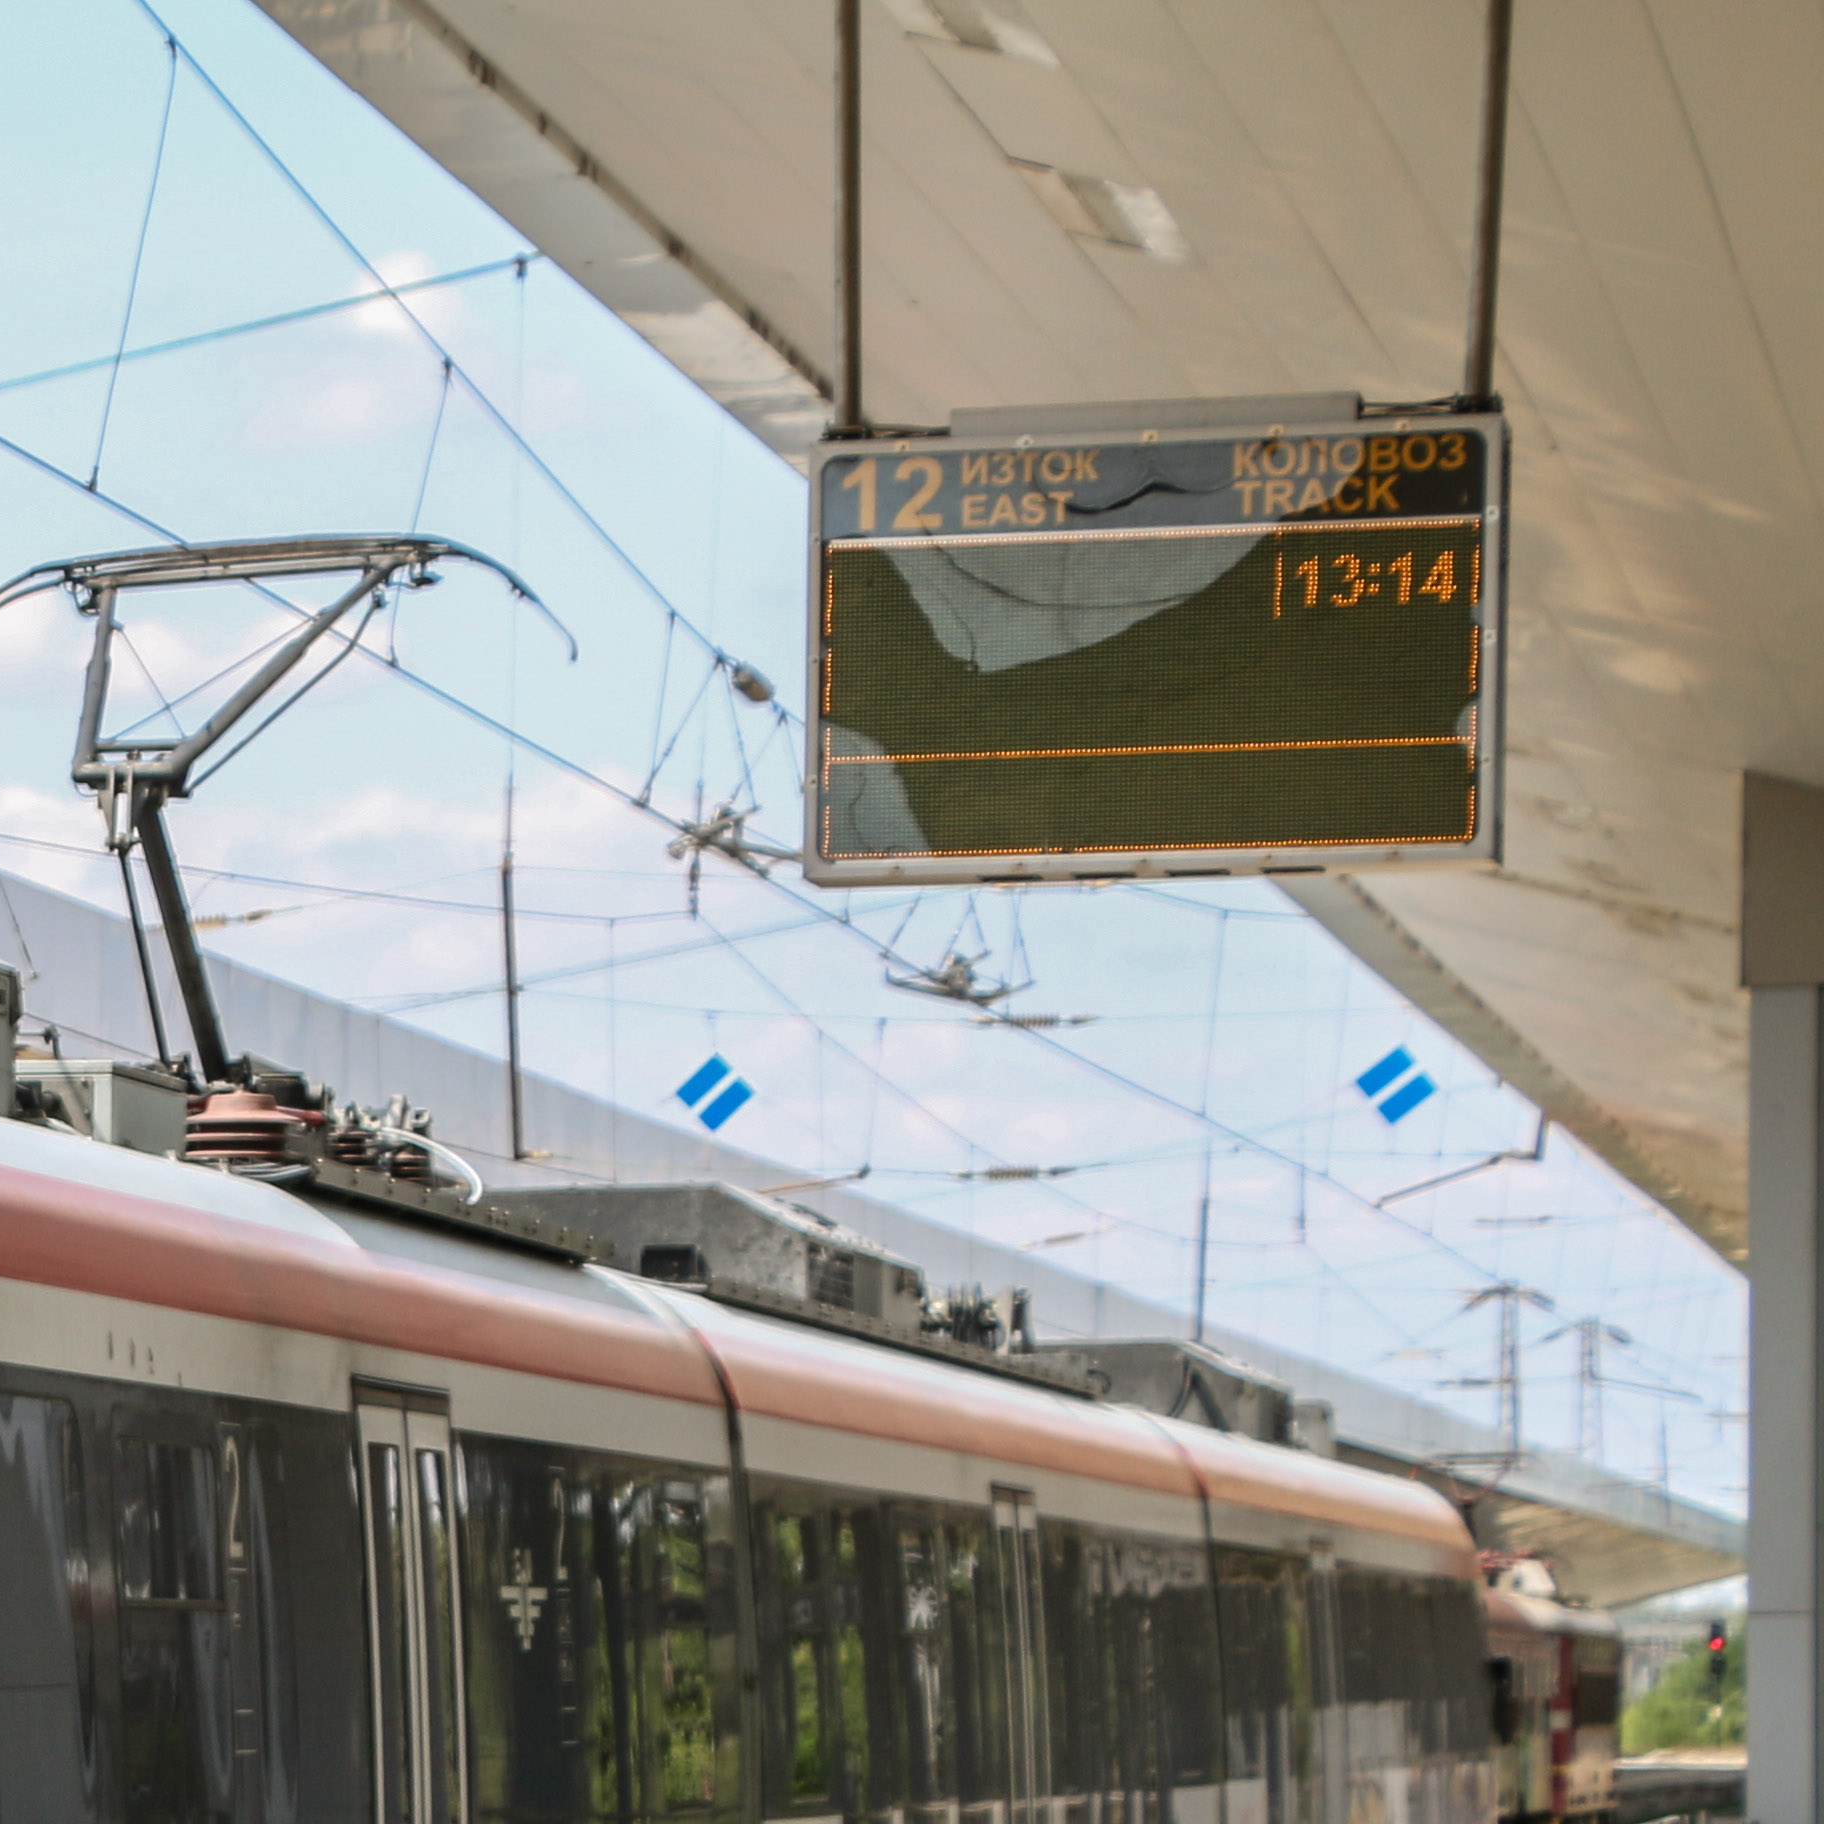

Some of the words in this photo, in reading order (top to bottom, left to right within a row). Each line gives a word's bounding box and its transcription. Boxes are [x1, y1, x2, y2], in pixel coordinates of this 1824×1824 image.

[960, 449, 1101, 486] ИЗТОК
[1232, 433, 1468, 478] КОЛОВОЗ
[841, 456, 944, 532] 12
[961, 492, 1074, 528] EAST
[1233, 474, 1401, 517] TRACK
[1296, 551, 1458, 608] 13:14
